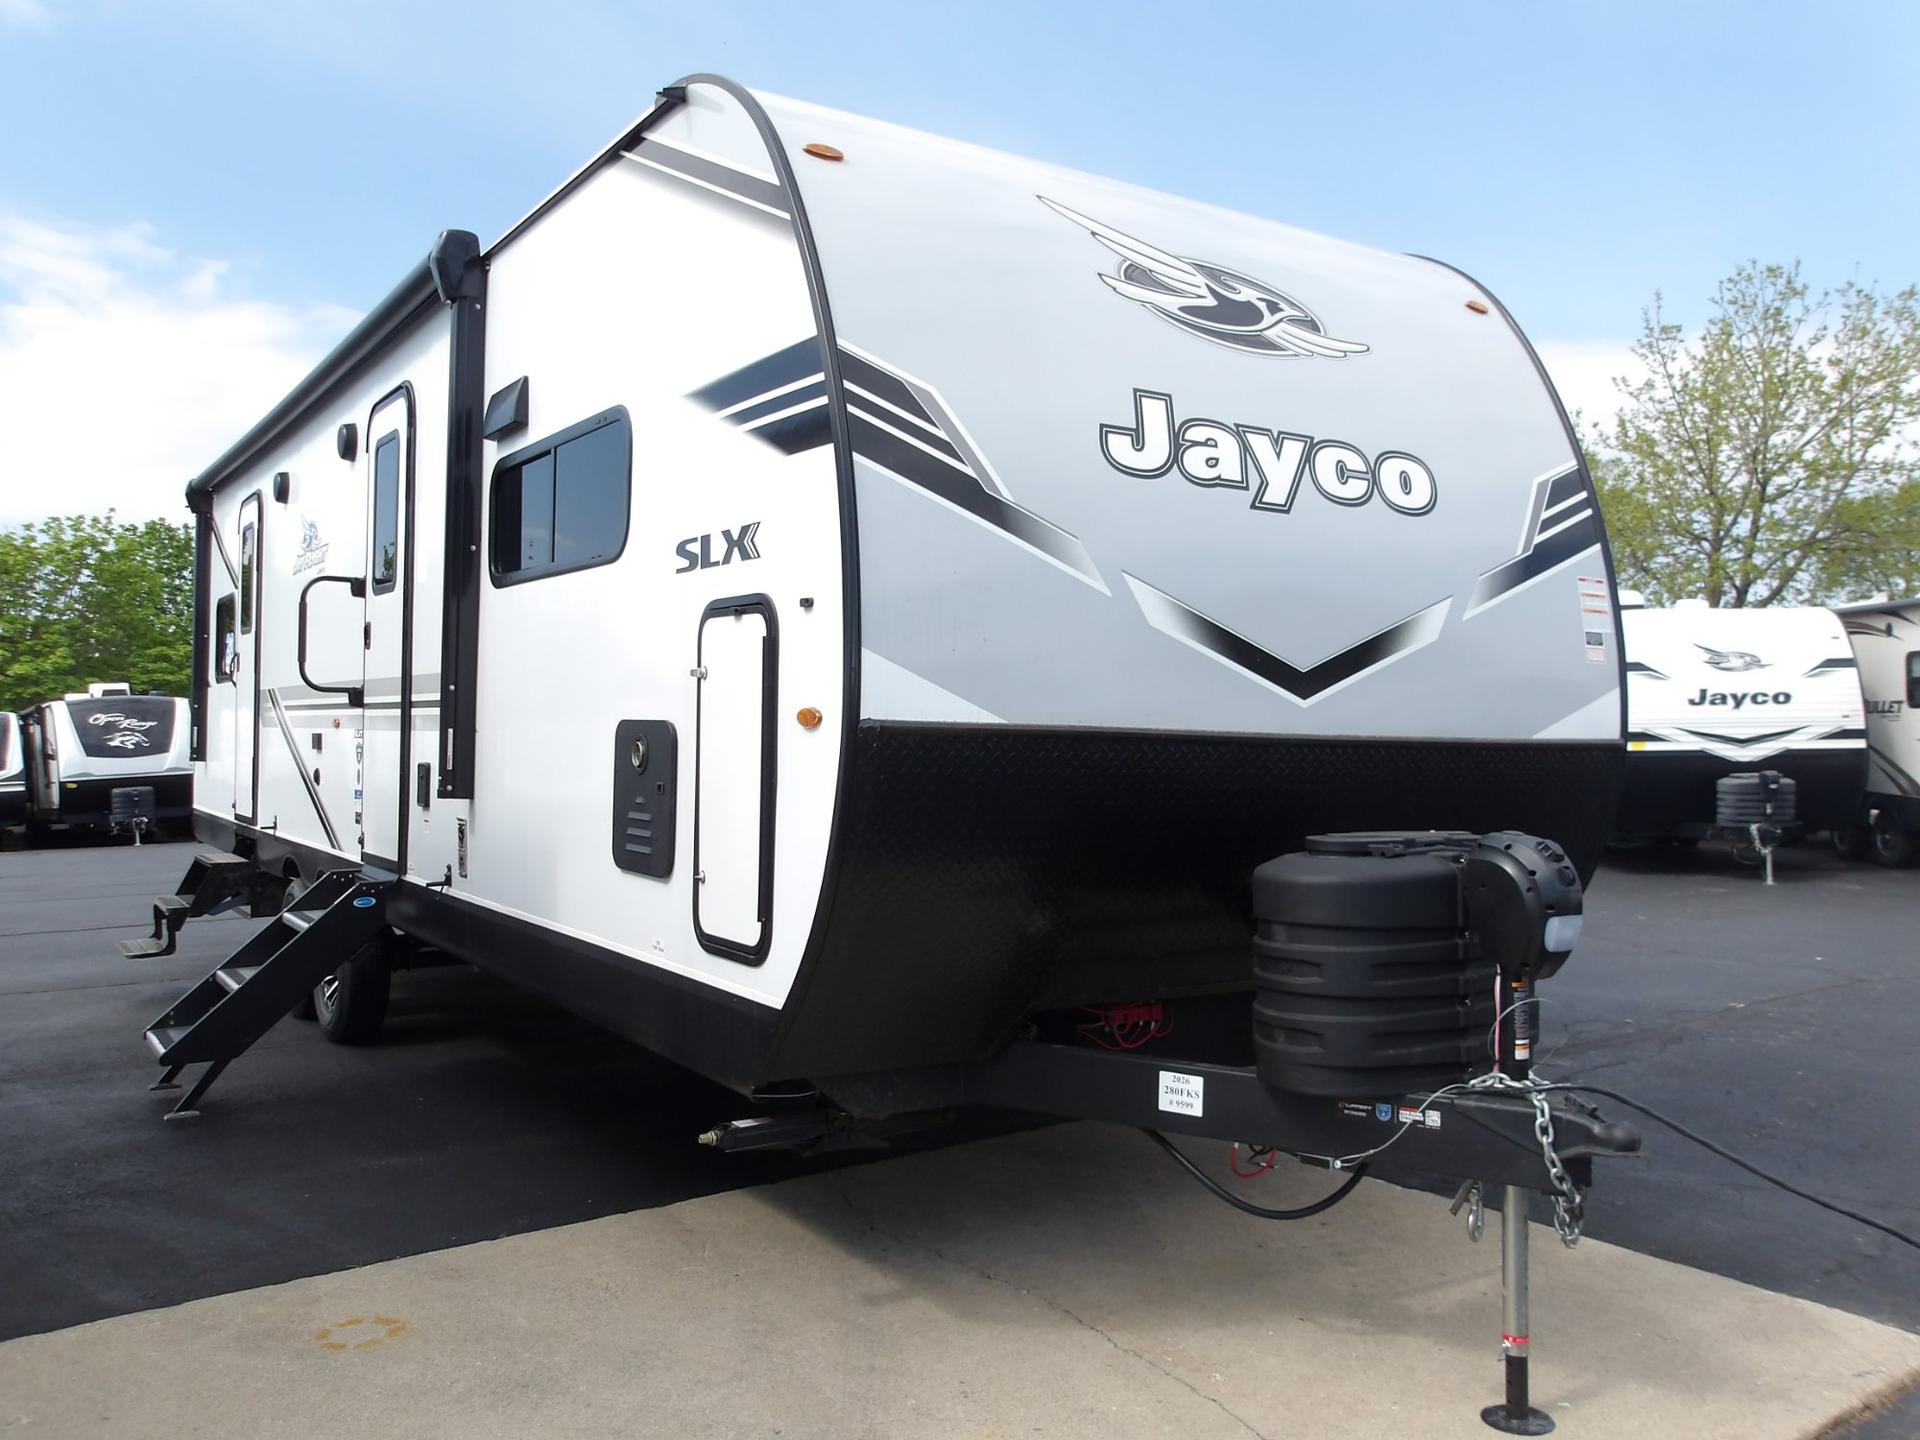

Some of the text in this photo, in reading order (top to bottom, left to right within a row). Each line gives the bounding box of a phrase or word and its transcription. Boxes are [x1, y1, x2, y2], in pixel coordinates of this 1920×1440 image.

[1099, 388, 1438, 517] Jayco
[676, 521, 761, 574] SLX
[1687, 688, 1792, 710] Jayco
[1864, 699, 1904, 714] ULLET
[88, 713, 158, 730] Open Range
[1172, 1074, 1191, 1085] 2026
[1164, 1085, 1200, 1099] 280FKS
